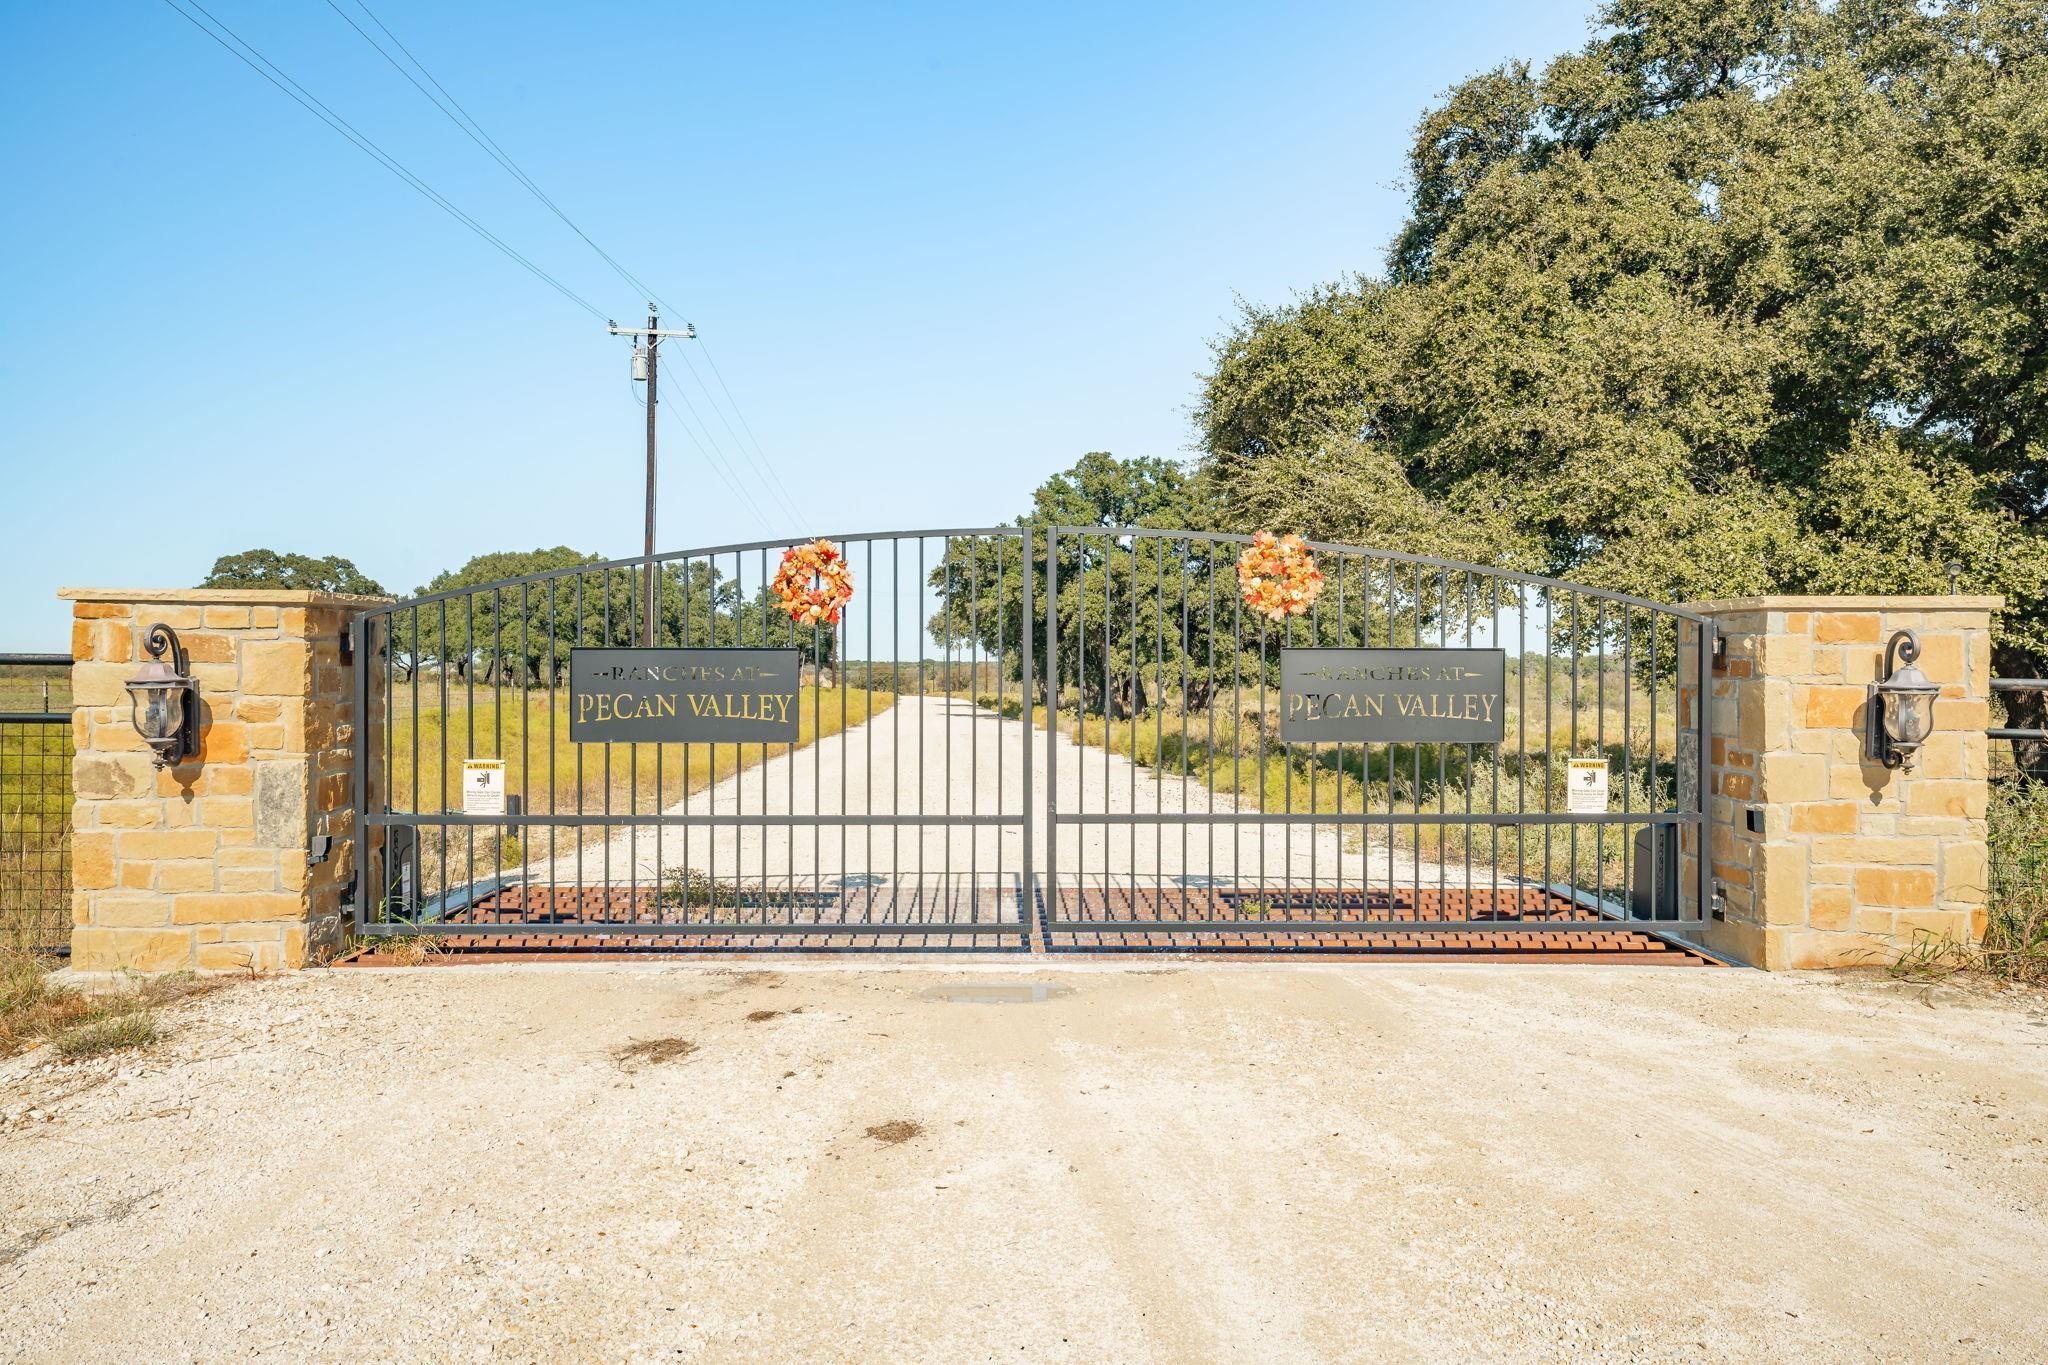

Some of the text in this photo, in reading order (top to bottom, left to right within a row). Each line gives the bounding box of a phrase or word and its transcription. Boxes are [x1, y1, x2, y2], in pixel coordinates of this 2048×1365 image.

[731, 666, 761, 681] AT
[1436, 666, 1465, 681] AT
[577, 693, 794, 723] PECAN VALLEY
[1287, 693, 1498, 723] PECAN VALLEY
